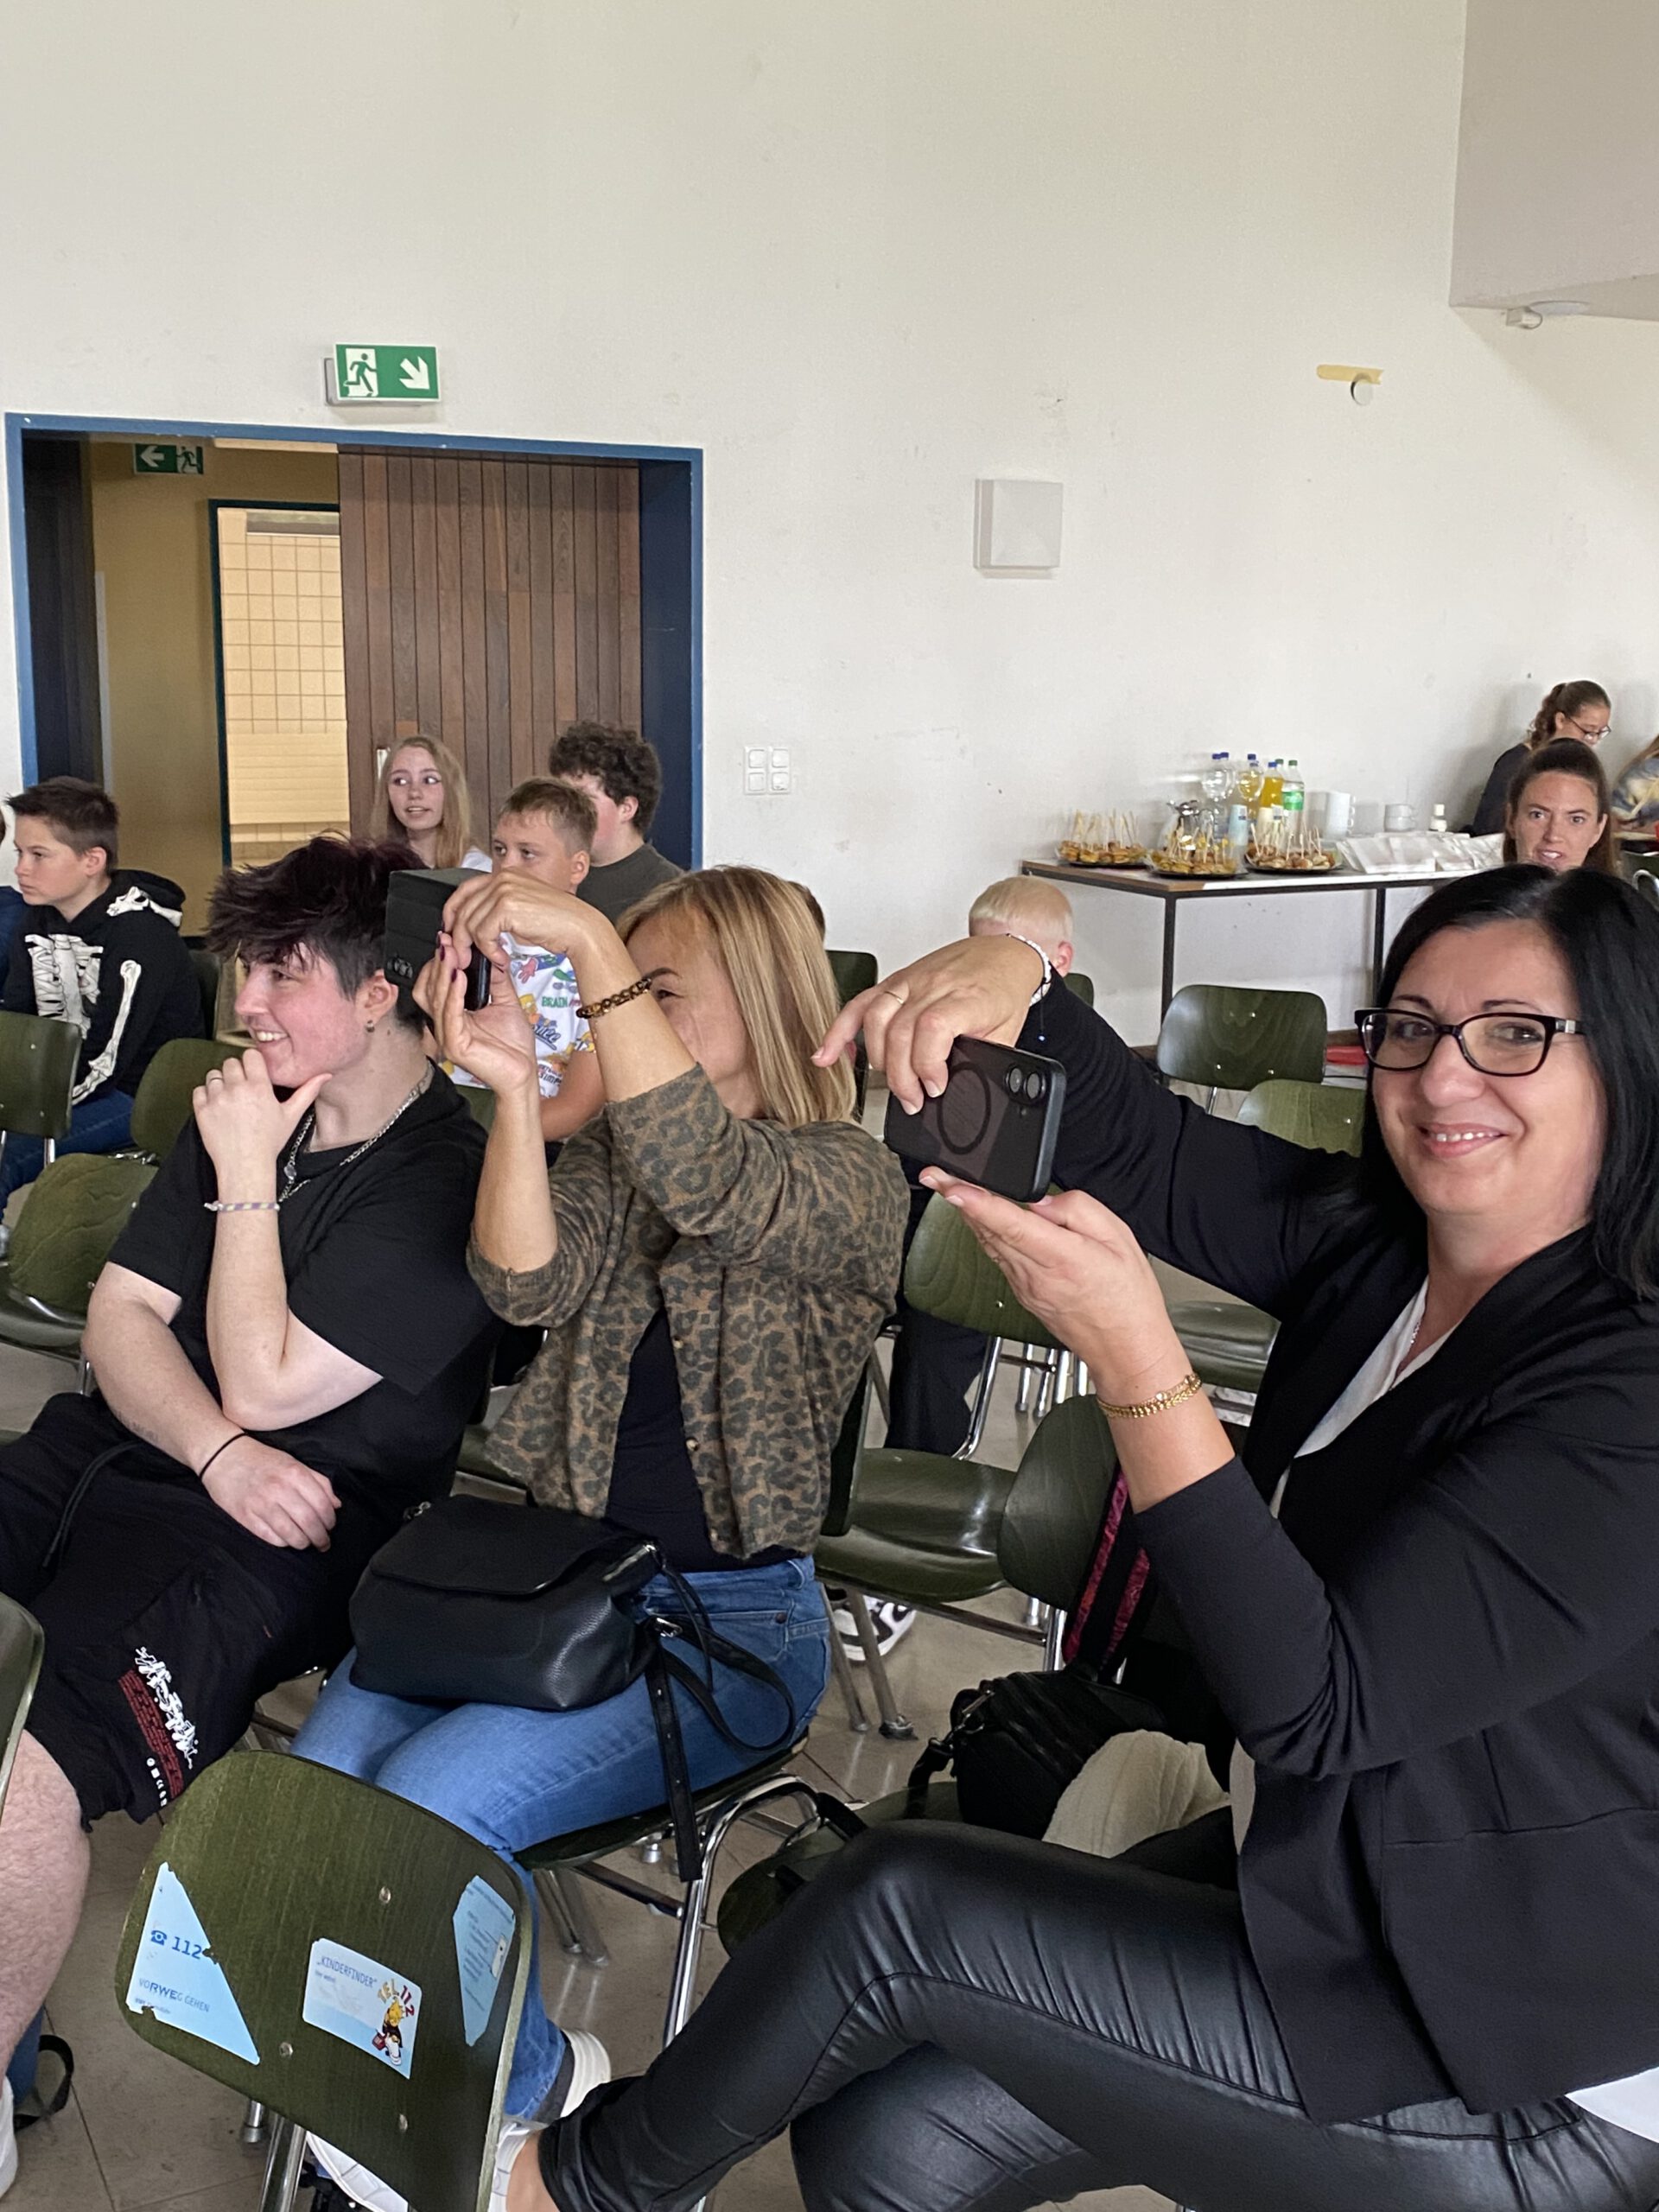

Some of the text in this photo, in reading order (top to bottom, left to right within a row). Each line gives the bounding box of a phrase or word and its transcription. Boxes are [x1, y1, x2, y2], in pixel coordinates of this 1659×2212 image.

[171, 1936, 202, 1960] 112
[138, 1978, 183, 2001] VORWEG
[184, 1995, 211, 2012] GEHEN
